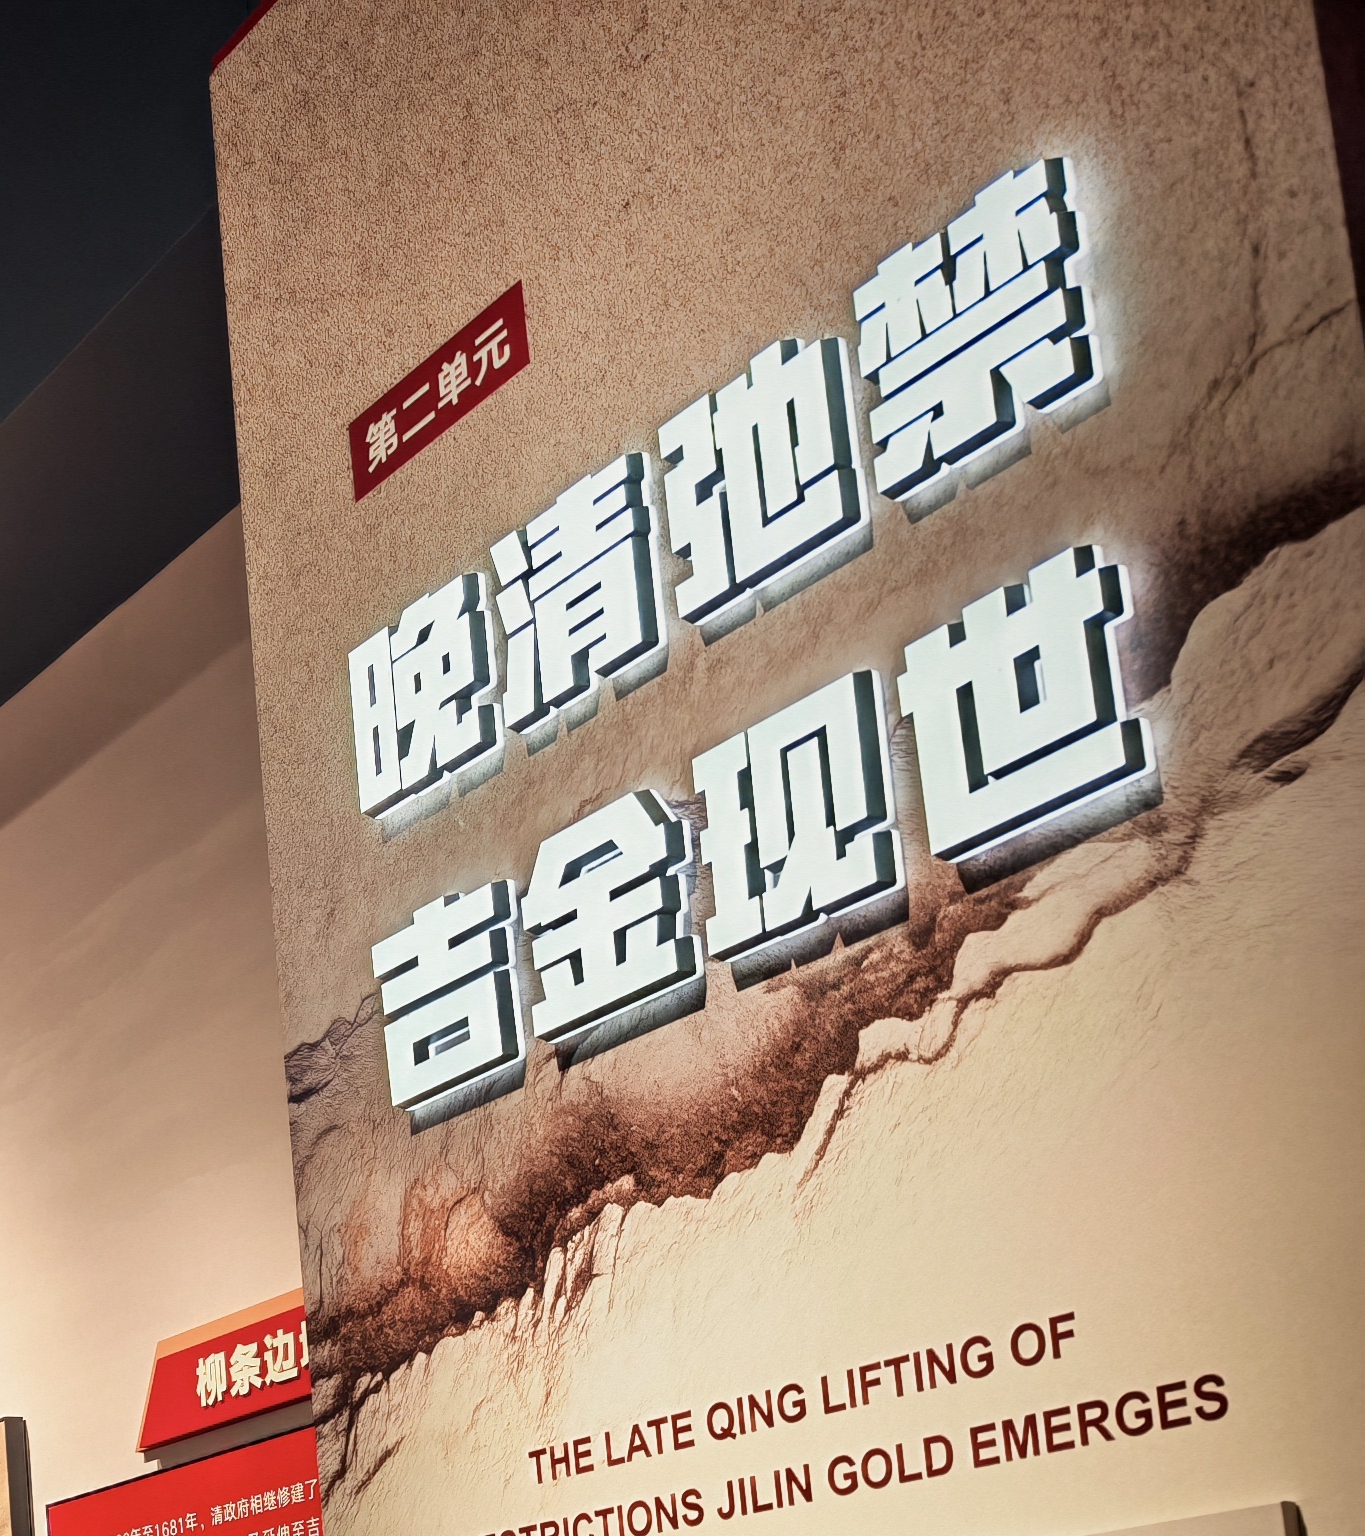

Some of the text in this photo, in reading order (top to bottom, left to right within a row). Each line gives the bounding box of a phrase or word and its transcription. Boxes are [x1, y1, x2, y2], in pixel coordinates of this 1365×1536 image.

[363, 320, 513, 474] 第二单元
[349, 157, 1103, 820] 晚清弛禁
[372, 545, 1157, 1113] 吉金现世
[529, 1312, 1078, 1487] THE LATE QING LIFTING OF
[716, 1462, 815, 1520] JILIN
[828, 1435, 954, 1496] GOLD
[971, 1373, 1230, 1470] EMERGES
